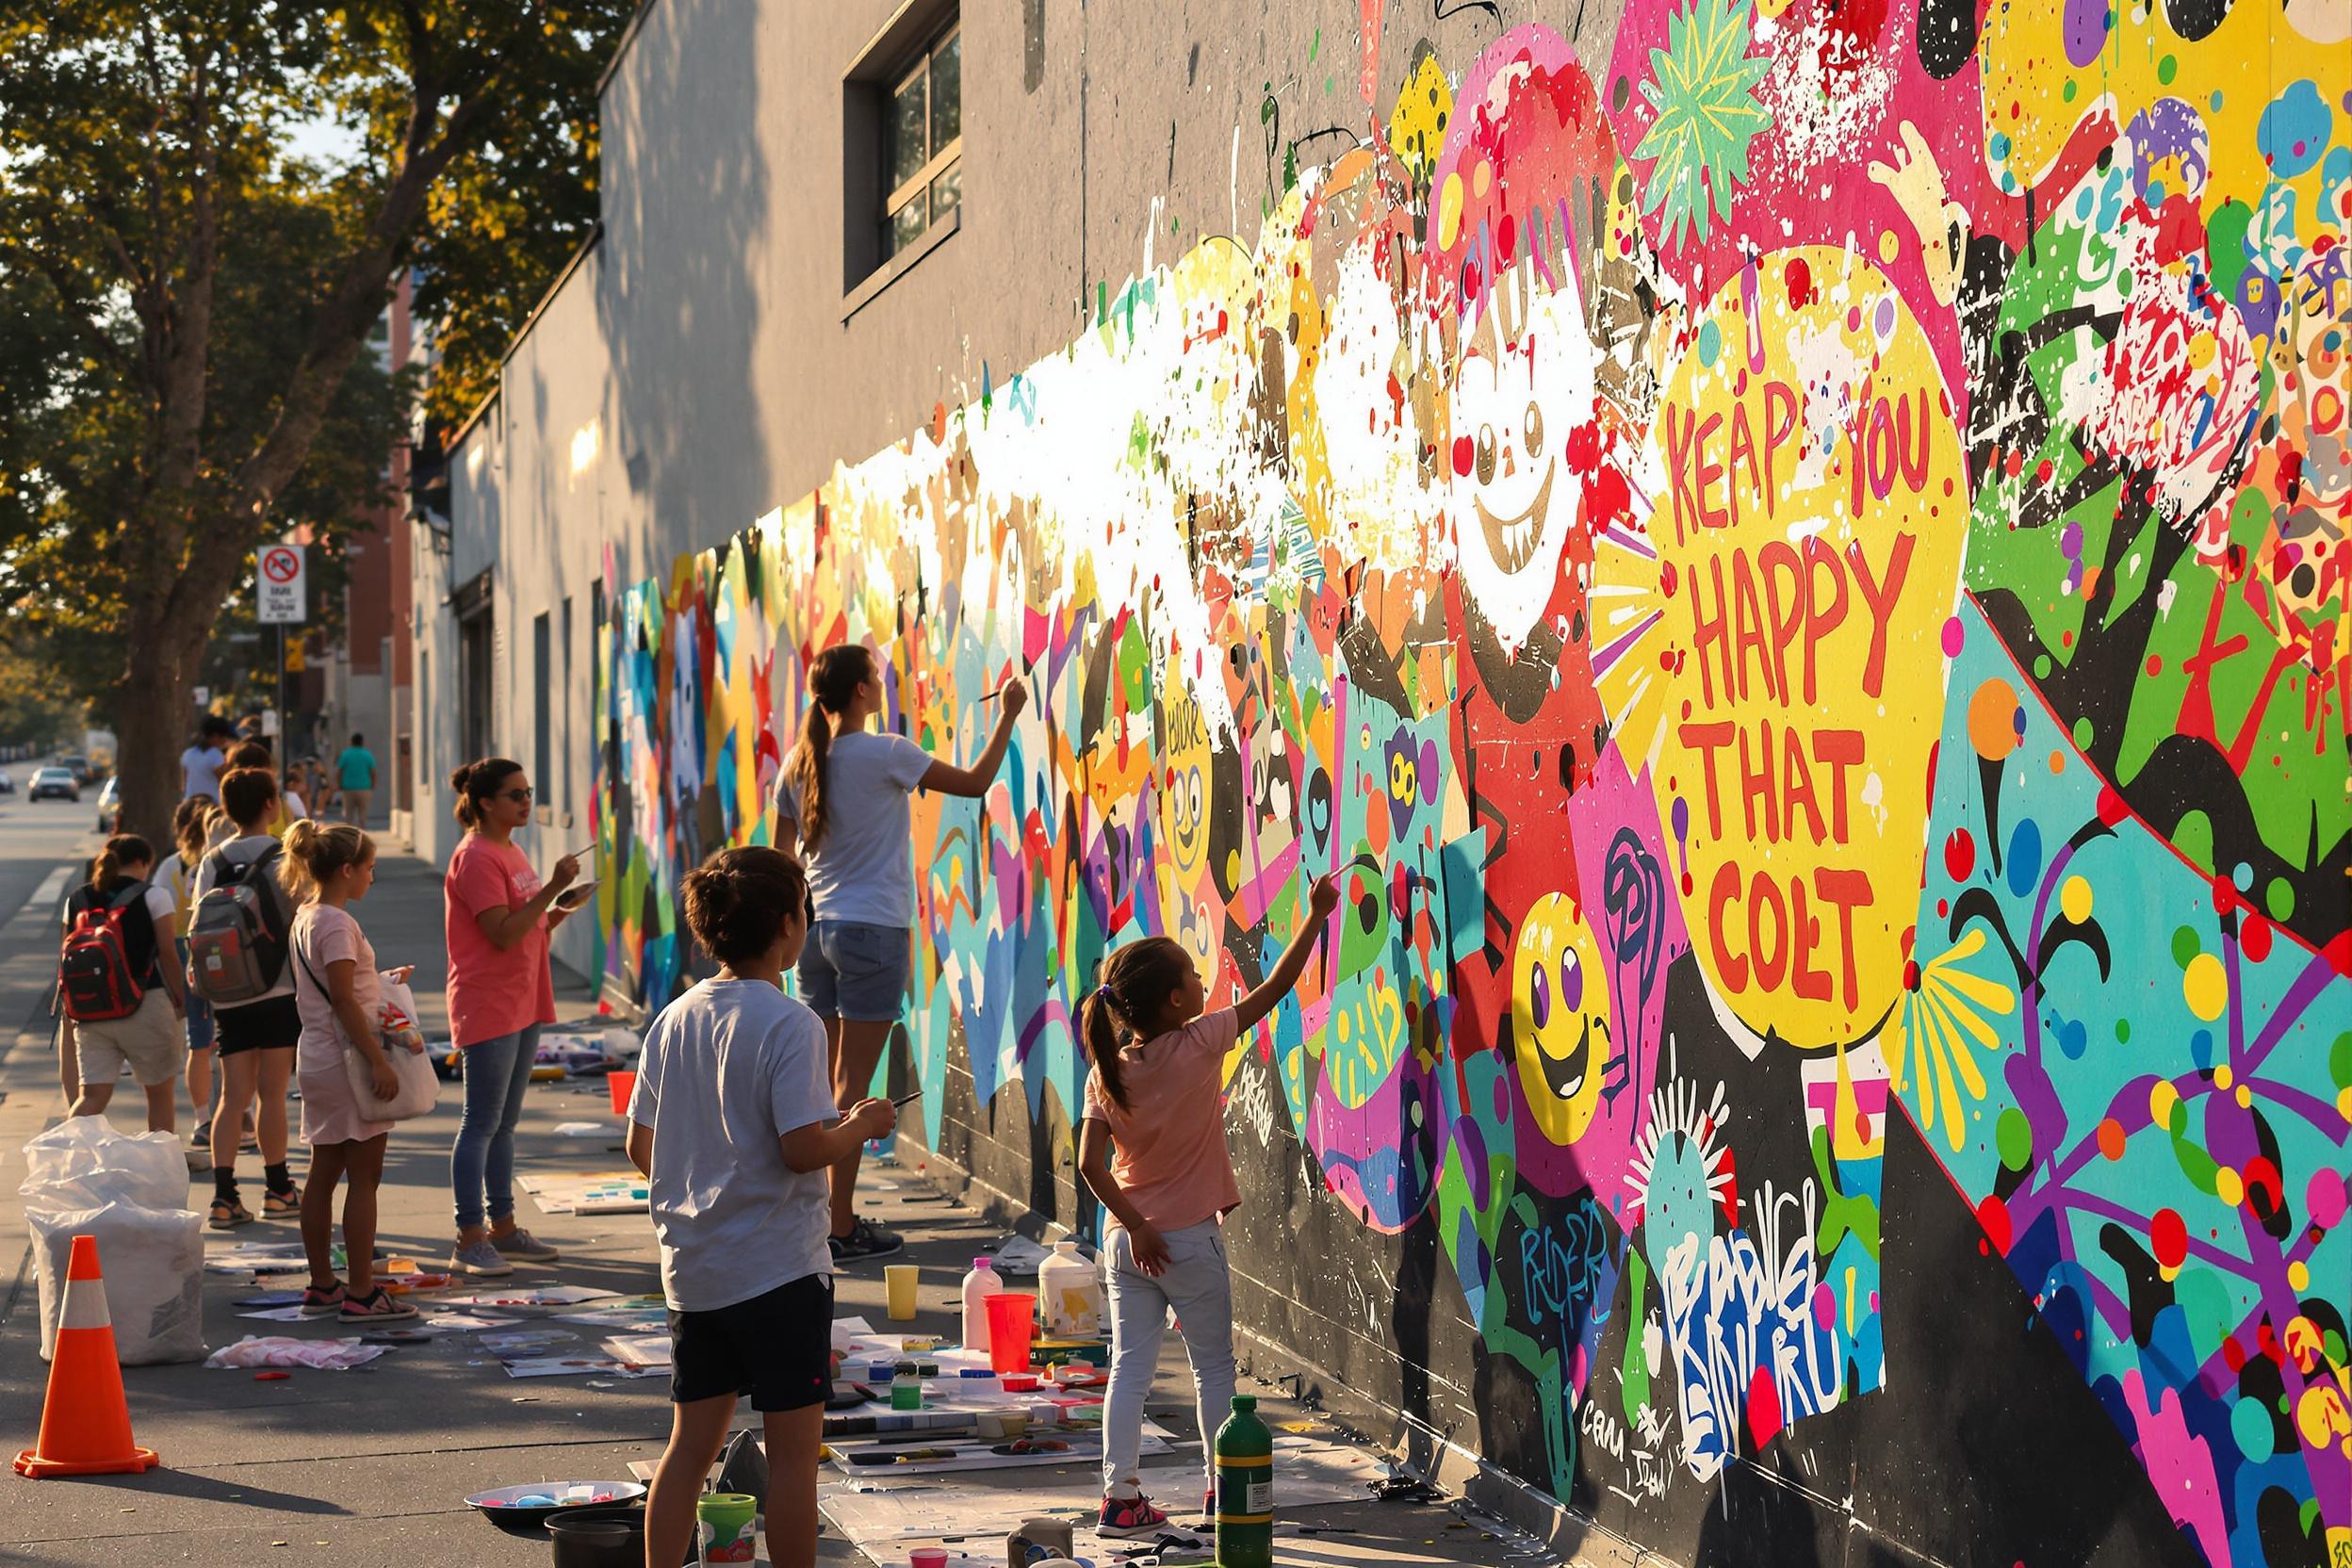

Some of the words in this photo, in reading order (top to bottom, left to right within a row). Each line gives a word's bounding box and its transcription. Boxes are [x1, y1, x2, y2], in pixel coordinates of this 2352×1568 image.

[1666, 381, 1797, 547] KEAP
[1838, 377, 1928, 519] YOU
[1688, 531, 1917, 710] HAPPY
[1678, 719, 1866, 846] THAT
